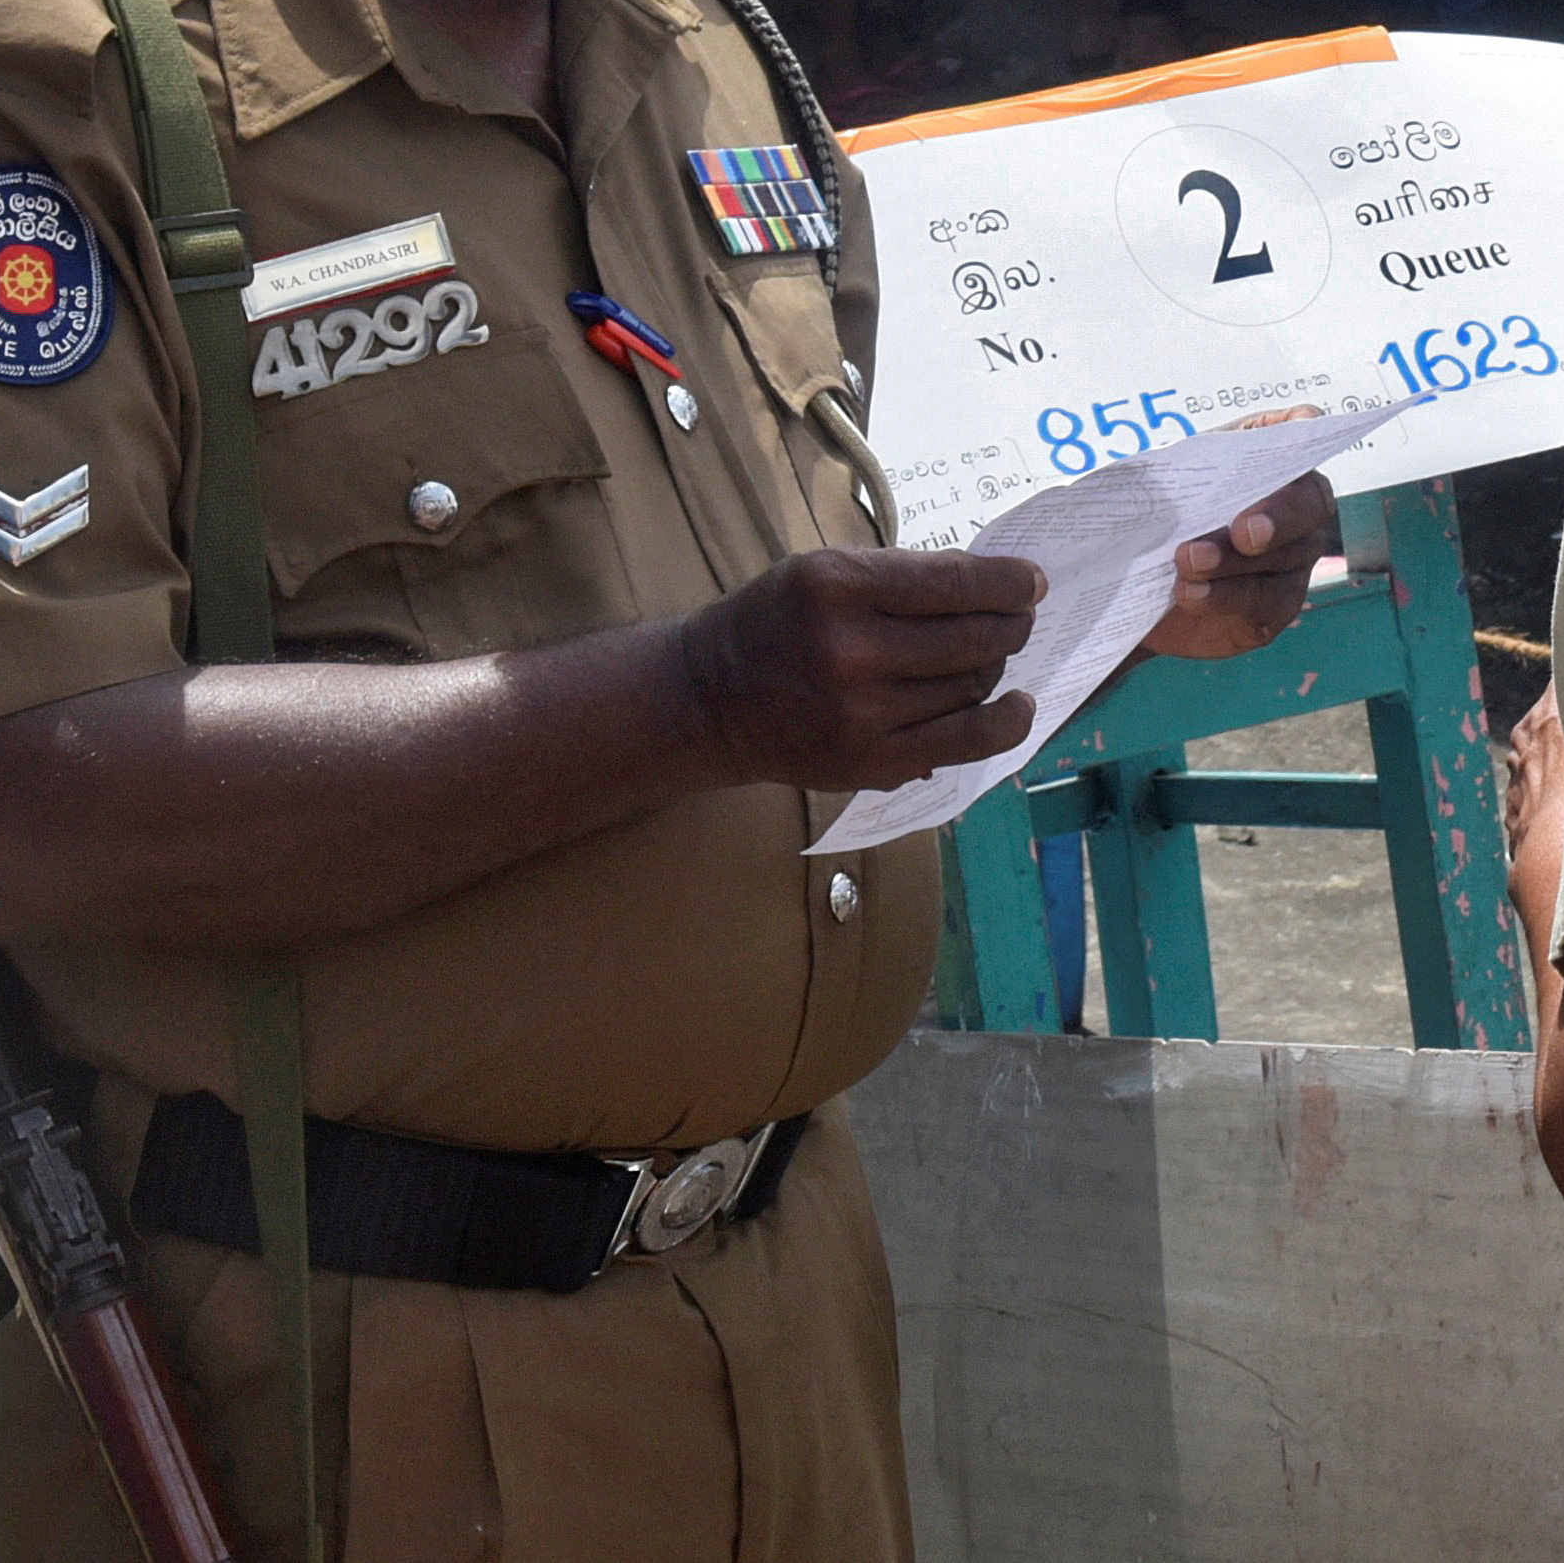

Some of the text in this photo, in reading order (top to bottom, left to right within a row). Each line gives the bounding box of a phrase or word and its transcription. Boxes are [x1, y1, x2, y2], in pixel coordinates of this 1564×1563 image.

[1330, 120, 1461, 169] පෝලිම
[1178, 169, 1274, 284] 2
[1354, 179, 1495, 226] வரிசை
[929, 209, 1009, 253] අංක
[270, 241, 420, 293] W.A. CHANDRASIRI
[952, 259, 1055, 315] இல.
[1379, 241, 1511, 292] Queue
[252, 280, 490, 400] 41292
[975, 332, 1057, 372] No.
[1378, 315, 1559, 406] 1623
[1294, 374, 1331, 394] අංක
[960, 445, 1000, 469] අංක
[1037, 389, 1197, 476] 855
[977, 474, 1032, 503] இல.
